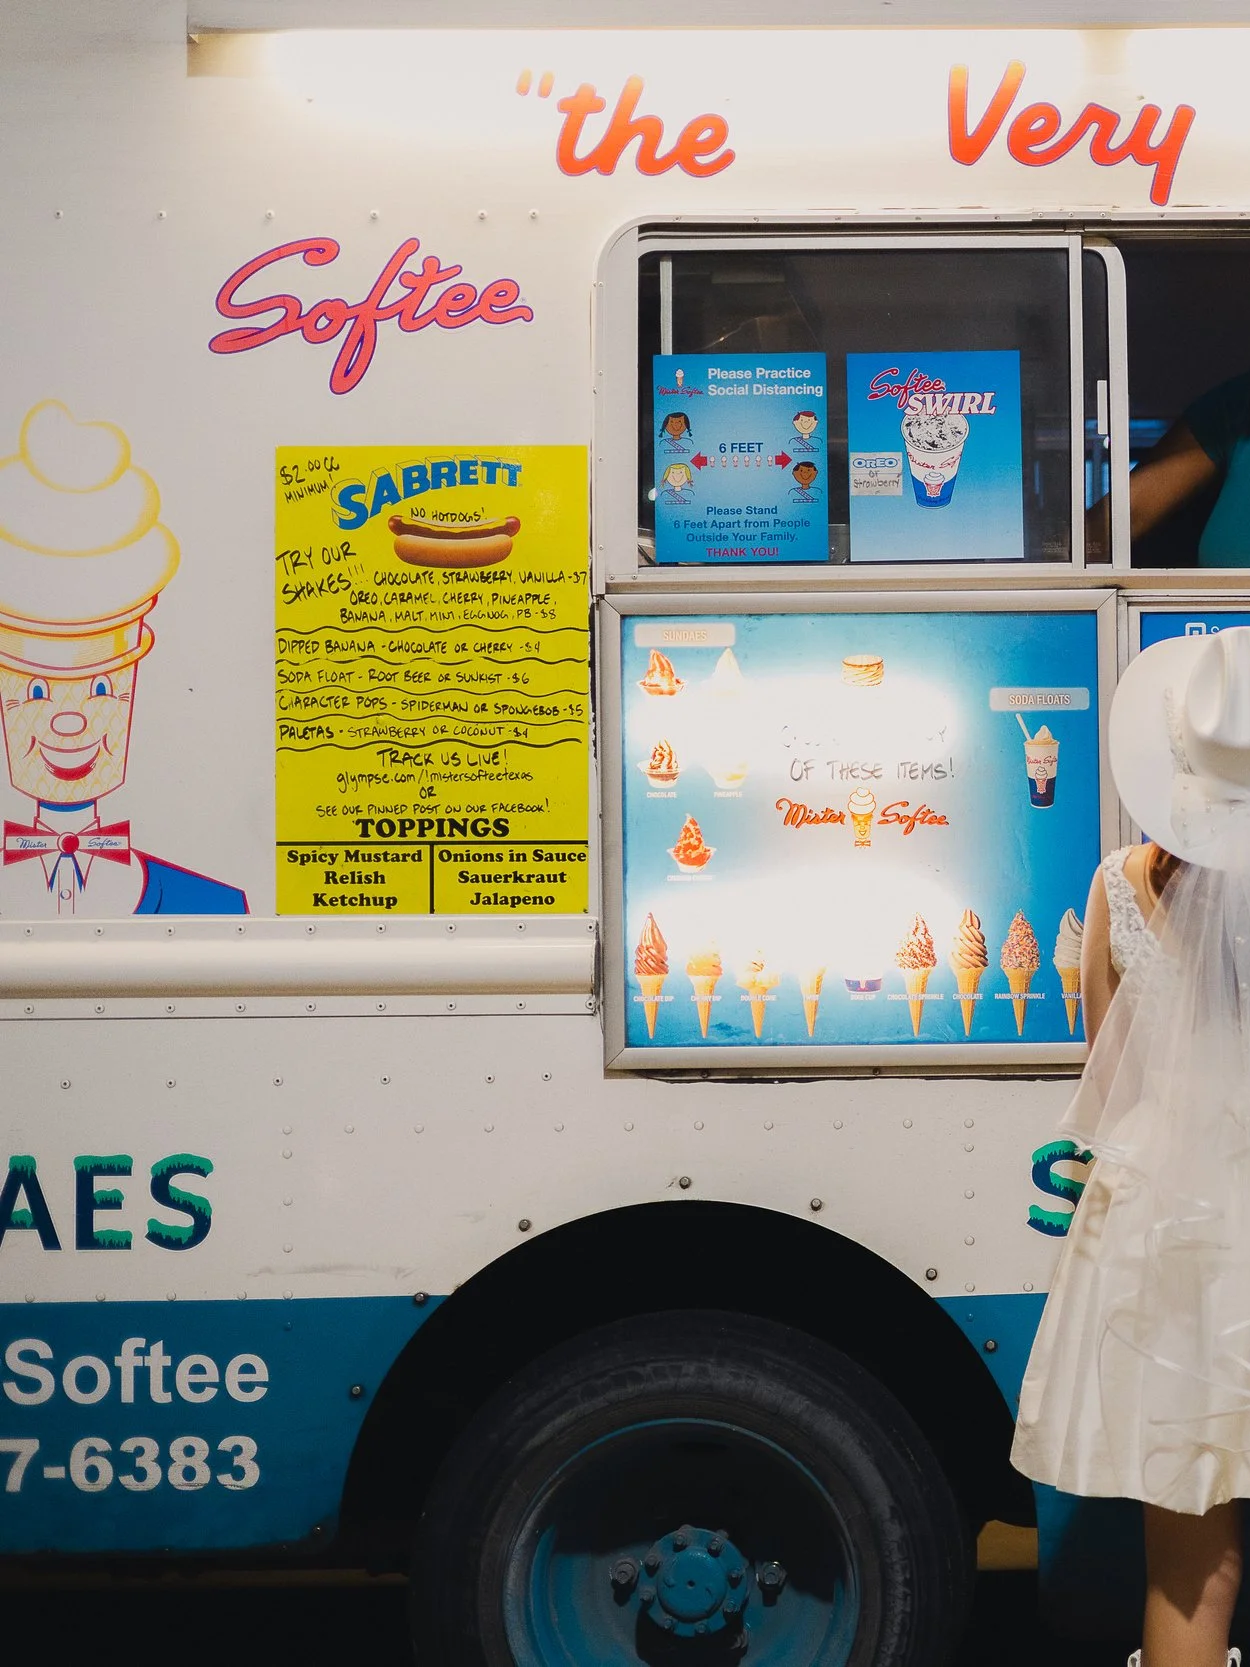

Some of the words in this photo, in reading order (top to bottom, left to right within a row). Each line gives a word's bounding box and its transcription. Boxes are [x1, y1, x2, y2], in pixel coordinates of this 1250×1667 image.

[515, 67, 736, 178] "the
[948, 59, 1196, 206] Very
[208, 237, 534, 395] Softee
[708, 367, 753, 380] Please
[756, 367, 811, 380] Practice
[708, 384, 749, 396] Social
[753, 383, 824, 397] Distancing
[867, 367, 946, 409] Softee
[904, 392, 997, 416] SWIRL
[719, 443, 727, 453] 6
[731, 442, 763, 453] FEET
[852, 458, 898, 469] OREO
[279, 459, 321, 486] $2.00
[331, 454, 523, 531] SABRETT
[410, 507, 426, 518] NO
[706, 506, 742, 516] Please
[745, 506, 778, 516] Stand
[673, 520, 681, 529] 6
[684, 520, 707, 529] Feet
[710, 519, 741, 530] Apart
[744, 519, 770, 528] from
[773, 518, 811, 530] People
[686, 533, 729, 543] Outside
[732, 532, 757, 542] Your
[760, 532, 798, 544] Family.
[275, 546, 314, 576] TRY
[322, 541, 357, 565] OUR
[706, 547, 746, 557] THANK
[750, 547, 779, 557] YOU!
[373, 570, 440, 586] CHOCOLATE,
[442, 570, 516, 585] STRAWBERRY,
[519, 571, 566, 584] VANILLA
[442, 592, 490, 606] CHERRY,
[339, 608, 392, 624] BANANA,
[394, 609, 428, 622] MALT,
[516, 609, 533, 618] PB
[663, 630, 708, 641] SUNDAES
[278, 638, 320, 654] DIPPED
[325, 639, 376, 654] BANANA
[454, 642, 469, 653] OR
[473, 641, 513, 653] CHERRY
[277, 669, 312, 684] SODA
[317, 669, 355, 684] FLOAT
[368, 668, 399, 683] ROOT
[403, 669, 432, 683] BEER
[438, 673, 452, 683] OR
[456, 671, 503, 685] SUNKIST
[278, 695, 351, 711] CHARACTER
[356, 696, 388, 711] POPS
[401, 698, 469, 712] SPIDERMAN
[473, 702, 489, 712] OR
[493, 703, 560, 717] SPONGEBOB
[1009, 694, 1035, 705] SODA
[1036, 694, 1071, 705] FLOATS
[279, 724, 335, 740] PALETAS
[347, 725, 426, 739] STRAWBERRY
[432, 725, 449, 735] OR
[453, 726, 505, 737] COCONUT
[376, 748, 434, 768] TRACK
[441, 752, 462, 767] US
[467, 749, 509, 767] LIVE!
[789, 758, 815, 782] OF
[826, 758, 883, 782] THESE
[897, 757, 955, 782] ITEMS!
[419, 786, 437, 799] OR
[316, 805, 338, 817] SEE
[342, 804, 364, 815] OUR
[367, 803, 408, 815] PINNED
[413, 804, 441, 815] POST
[445, 804, 462, 814] ON
[465, 804, 487, 814] OUR
[775, 798, 846, 829] Mister
[877, 801, 950, 836] Softee
[355, 817, 510, 838] TOPPINGS
[16, 837, 48, 849] Mister
[286, 849, 339, 865] Spicy
[344, 849, 423, 863] Mustard
[437, 849, 504, 863] Onions
[508, 849, 527, 863] in
[532, 849, 587, 863] Sauce
[323, 871, 386, 885] Relish
[457, 871, 567, 884] Sauerkraut
[312, 892, 398, 910] Ketchup
[470, 892, 555, 908] Jalapeno
[0, 1152, 215, 1252] AES
[2, 1337, 270, 1405] Softee
